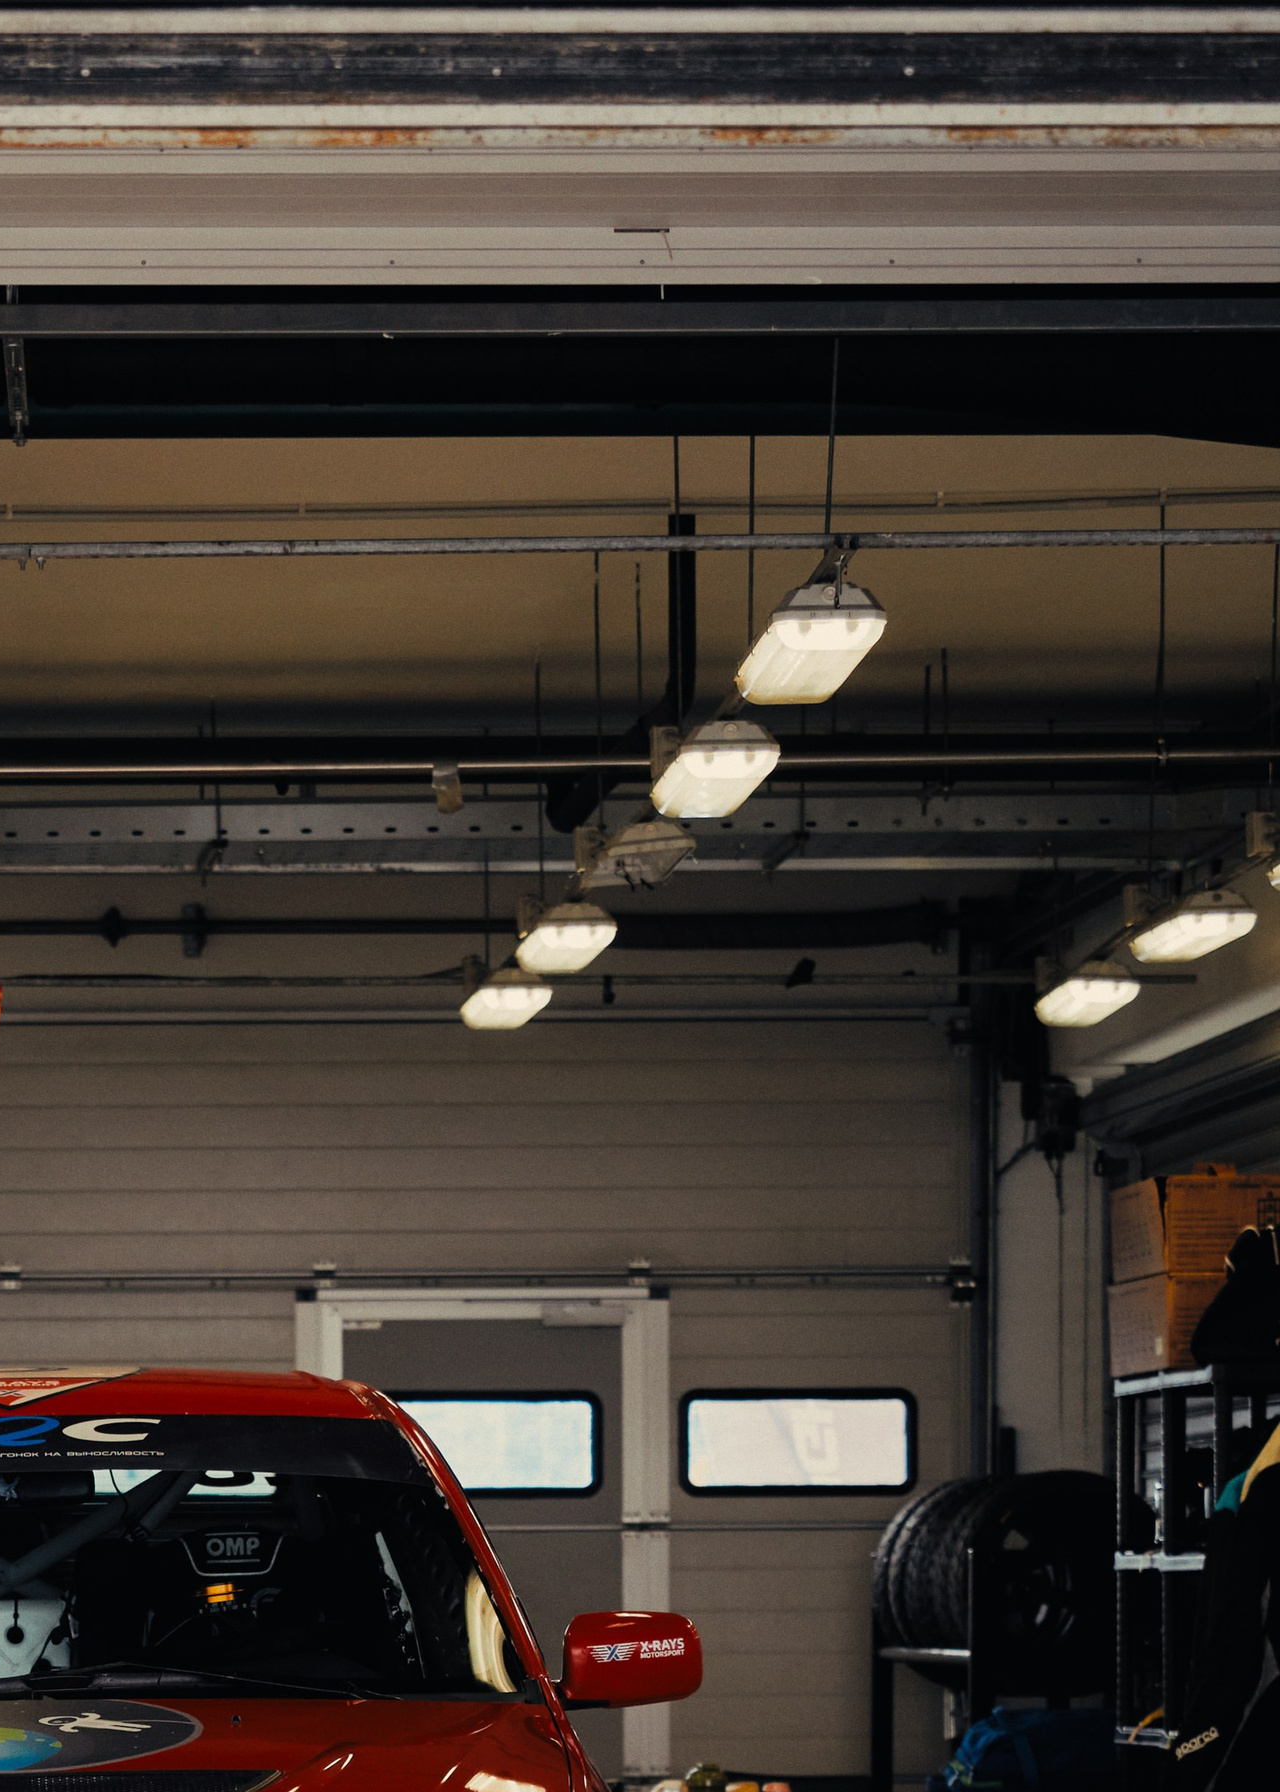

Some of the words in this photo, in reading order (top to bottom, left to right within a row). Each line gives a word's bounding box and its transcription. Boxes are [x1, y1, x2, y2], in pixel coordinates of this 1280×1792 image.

[66, 1449, 166, 1457] ВЫНОСЛИВОСТЬ
[206, 1536, 261, 1557] OMP
[640, 1637, 685, 1654] X-RAYS
[640, 1648, 685, 1659] MOTORSPORT
